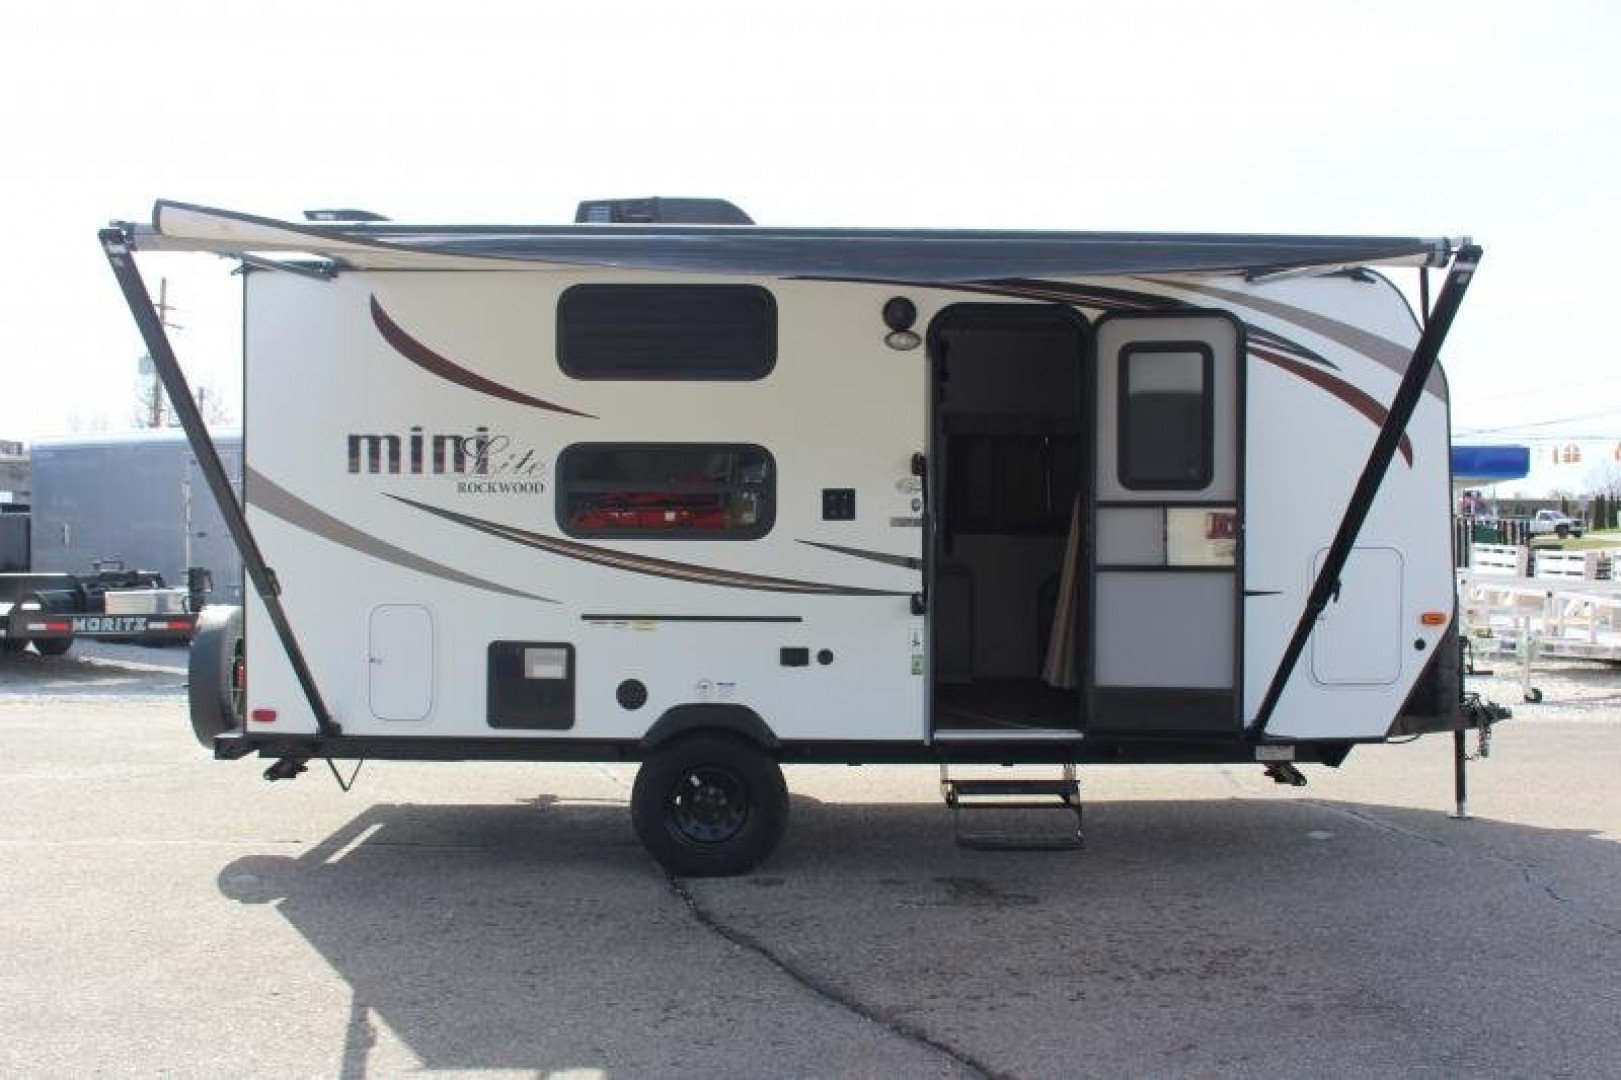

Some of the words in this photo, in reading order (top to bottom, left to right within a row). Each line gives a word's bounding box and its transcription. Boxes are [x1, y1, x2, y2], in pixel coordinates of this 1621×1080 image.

[348, 426, 488, 474] mini
[457, 481, 545, 494] ROCKWOOD
[72, 617, 147, 633] MORITZ
